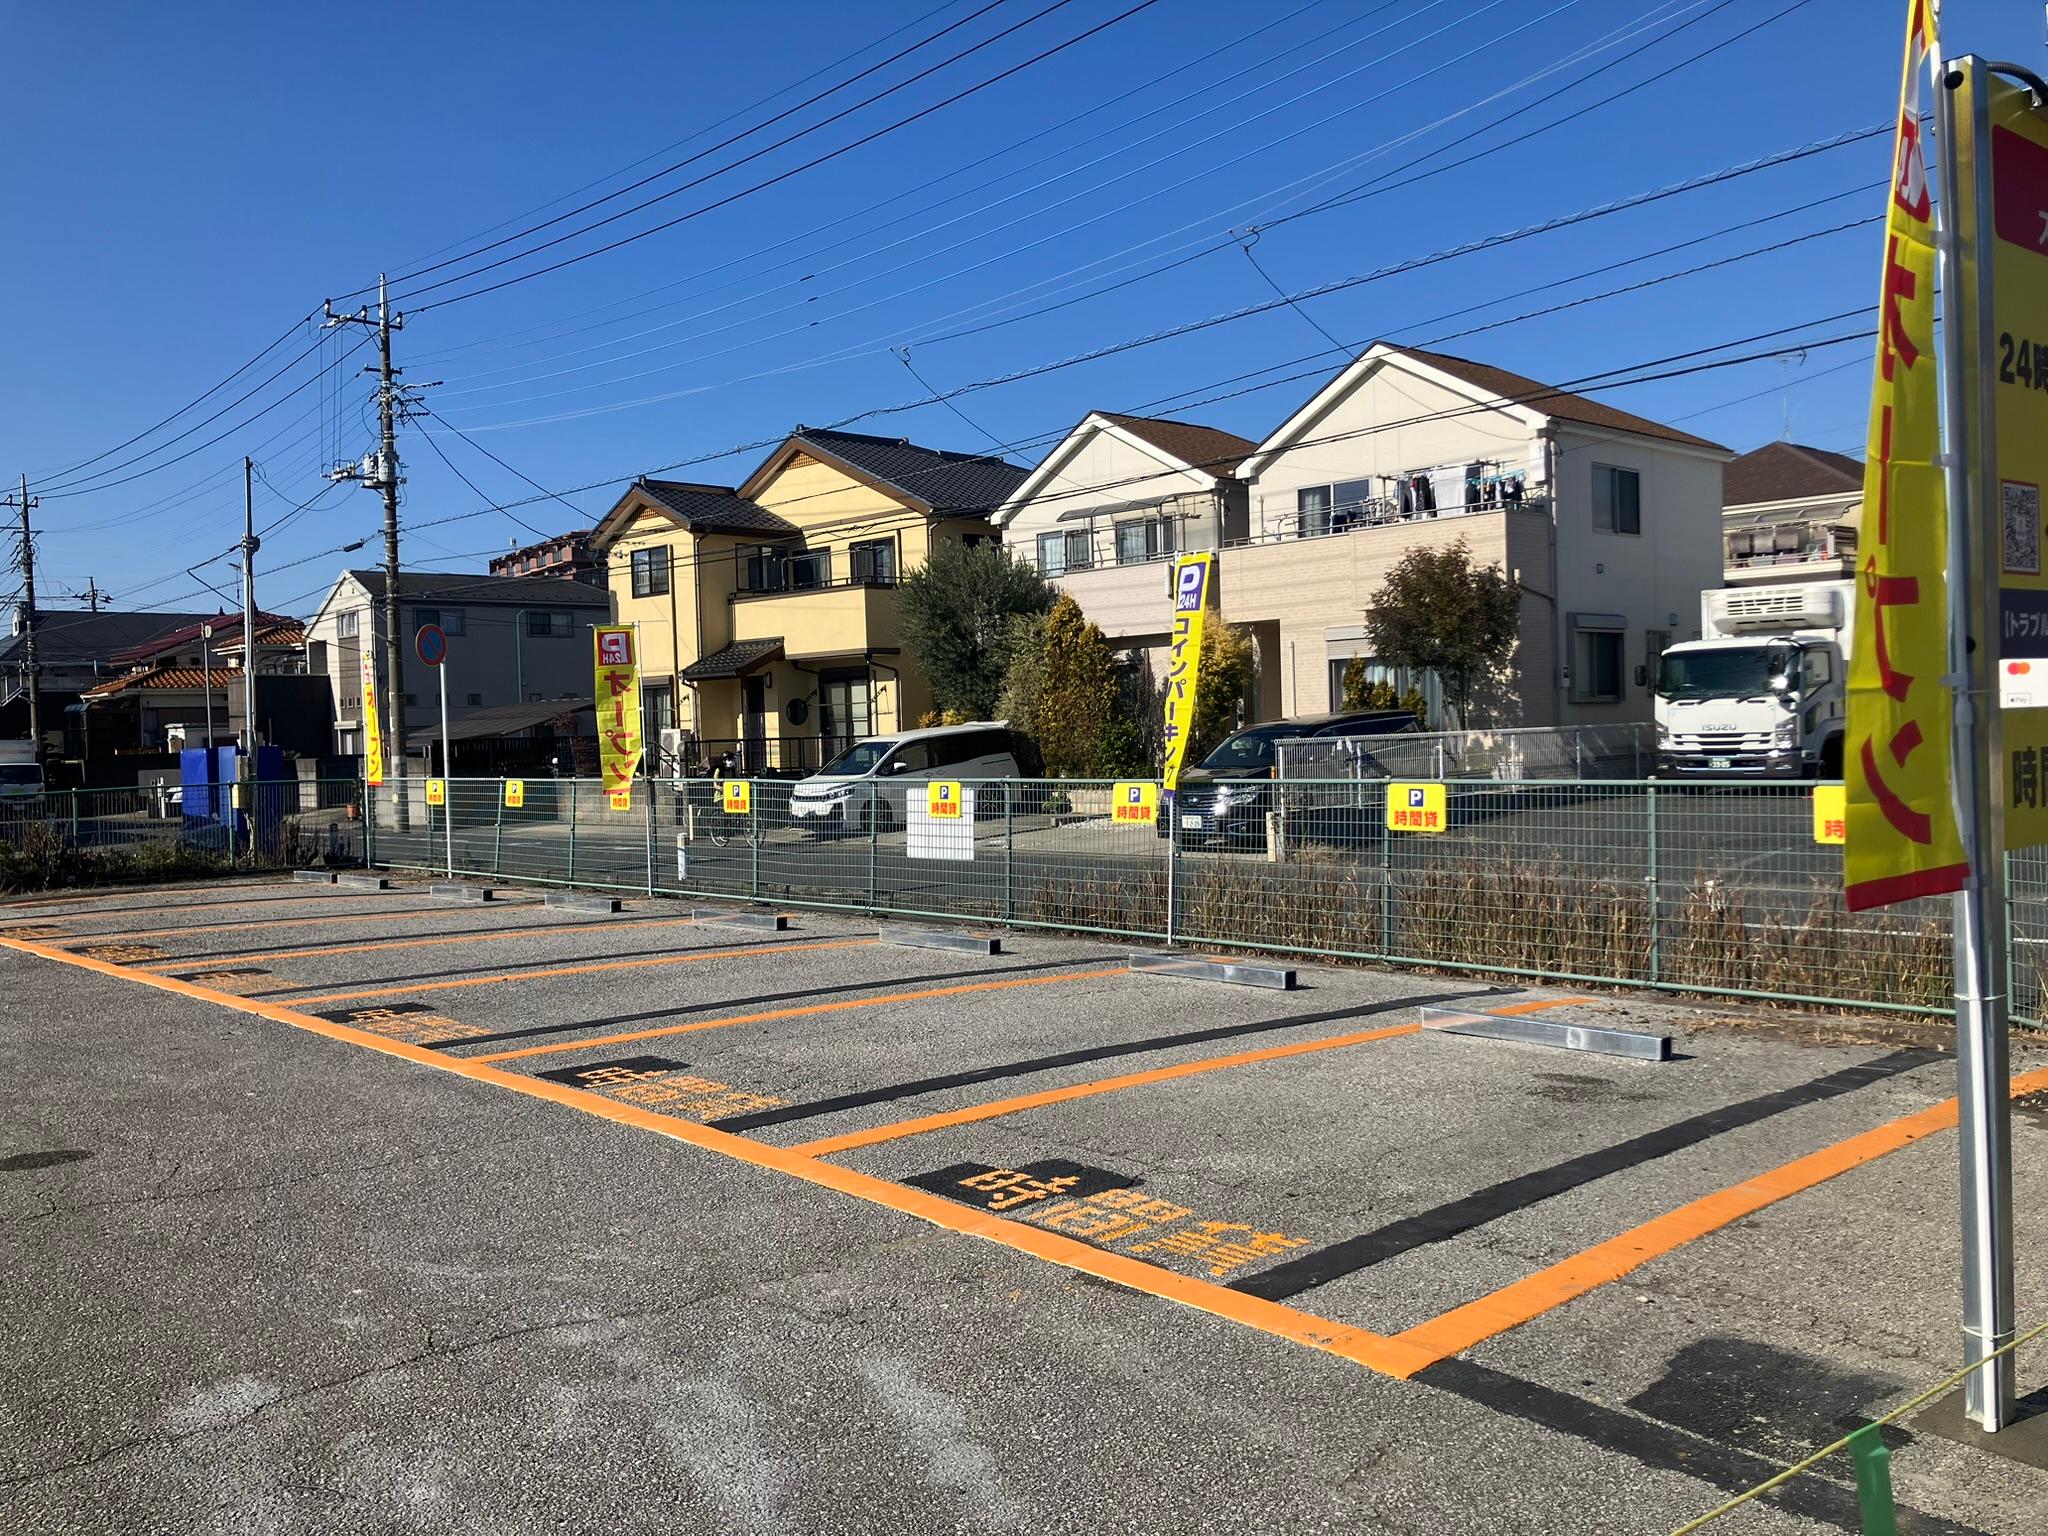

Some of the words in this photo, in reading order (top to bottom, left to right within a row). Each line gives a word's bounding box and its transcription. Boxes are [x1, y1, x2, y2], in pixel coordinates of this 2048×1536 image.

[1177, 565, 1200, 609] P
[1702, 723, 1737, 731] ISUZU
[940, 786, 948, 798] P
[1130, 788, 1139, 802] P
[1410, 790, 1422, 805] P
[1116, 805, 1151, 819] 時間貸
[1394, 810, 1438, 827] 時間貸
[958, 1167, 1311, 1277] 時間貸
